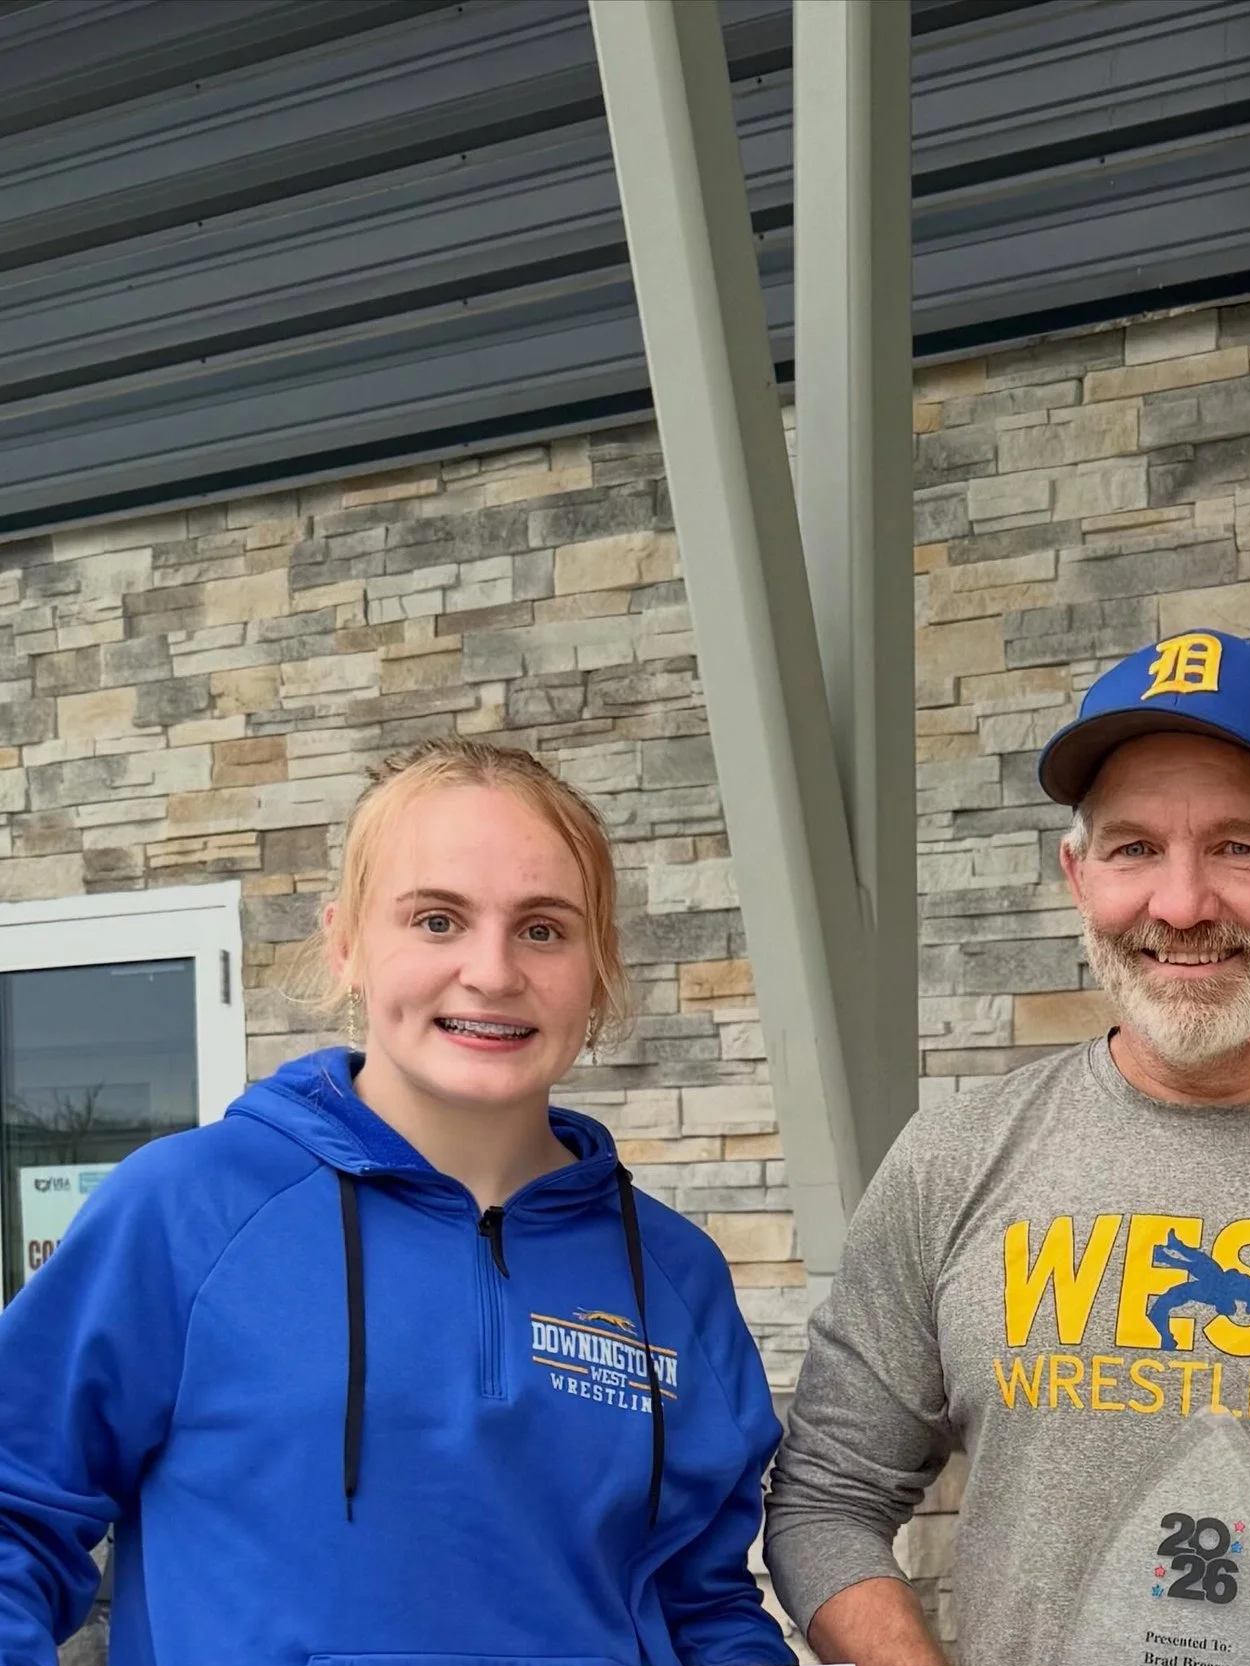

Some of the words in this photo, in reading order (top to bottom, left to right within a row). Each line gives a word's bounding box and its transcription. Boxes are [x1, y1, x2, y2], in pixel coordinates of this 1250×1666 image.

[1140, 633, 1223, 700] D
[531, 1321, 678, 1387] DOWNINGTOWN
[590, 1366, 628, 1388] WEST
[551, 1373, 664, 1413] WRESTLIN
[1157, 1512, 1231, 1560] 20
[1167, 1554, 1239, 1604] 26
[1145, 1631, 1207, 1650] Presented
[1212, 1640, 1232, 1653] To:
